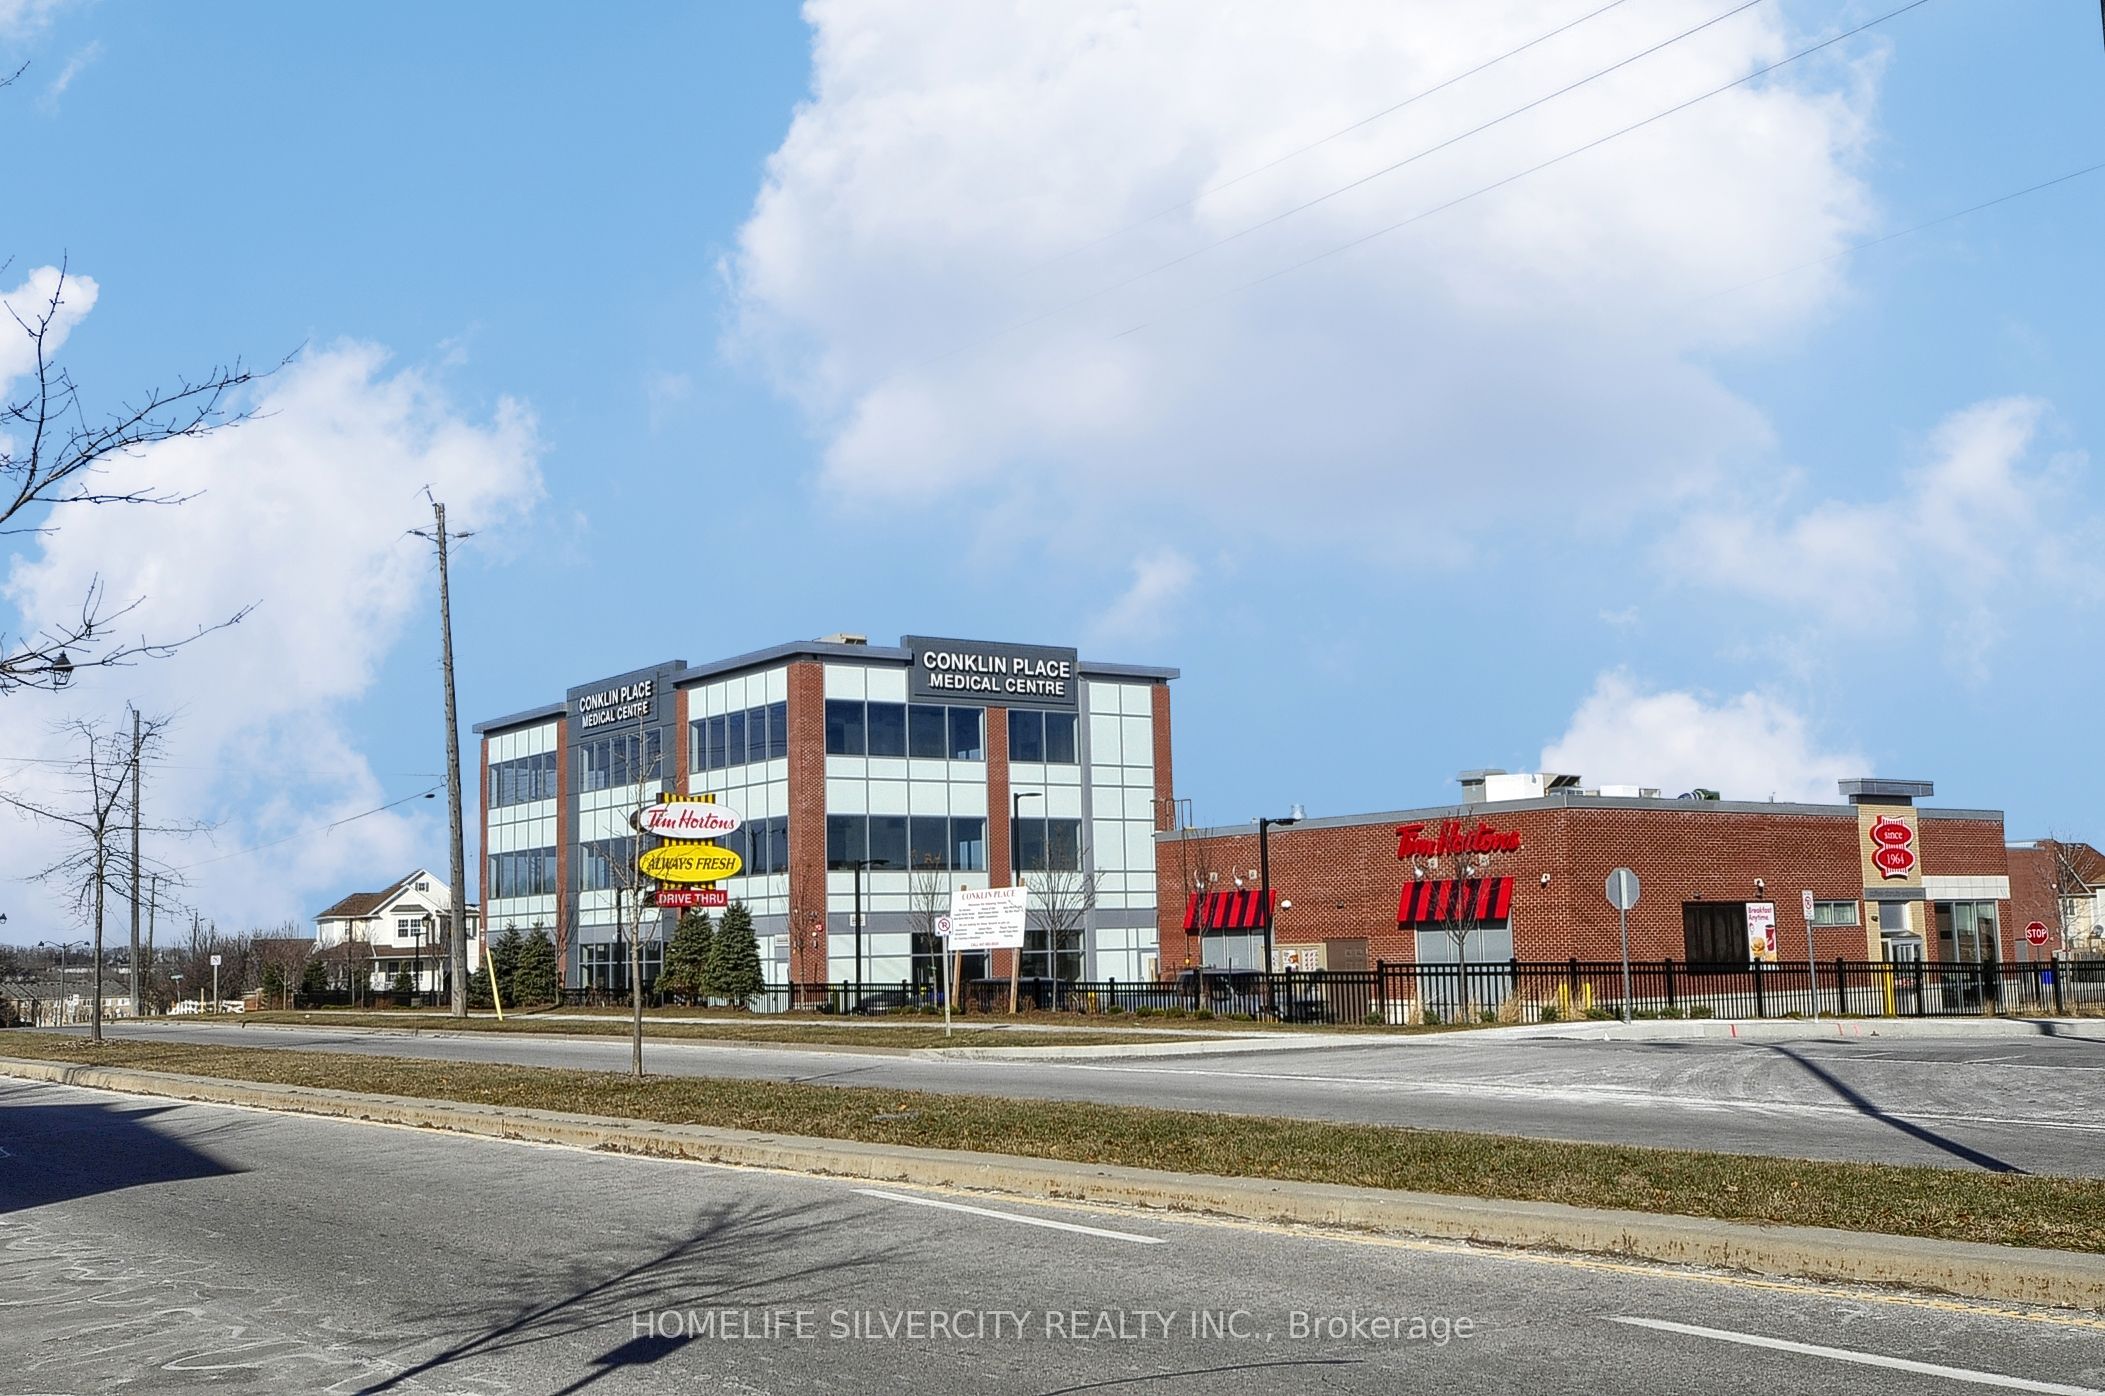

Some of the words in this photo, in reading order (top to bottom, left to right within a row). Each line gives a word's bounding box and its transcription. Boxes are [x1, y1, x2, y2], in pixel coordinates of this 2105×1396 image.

[923, 651, 1007, 674] CONKLIN
[1013, 658, 1071, 678] PLACE
[930, 673, 1001, 692] MEDICAL
[1005, 678, 1065, 696] CENTRE
[579, 688, 619, 713] CONKLIN
[620, 680, 653, 702] PLACE
[582, 709, 616, 729] MEDICAL
[648, 809, 677, 829] Tim
[678, 809, 735, 830] Hortons
[1396, 824, 1437, 860] Tim
[1436, 820, 1520, 856] Hortons
[1884, 828, 1903, 840] since
[647, 857, 694, 871] ALWAYS
[695, 857, 737, 871] FRESH
[1886, 853, 1905, 865] 1964
[658, 893, 692, 904] DRIVE
[693, 893, 725, 904] THRU
[962, 891, 992, 900] CONKLIN
[993, 890, 1016, 898] PLACE
[1748, 906, 1772, 914] Breakfast
[2027, 929, 2047, 938] STOP
